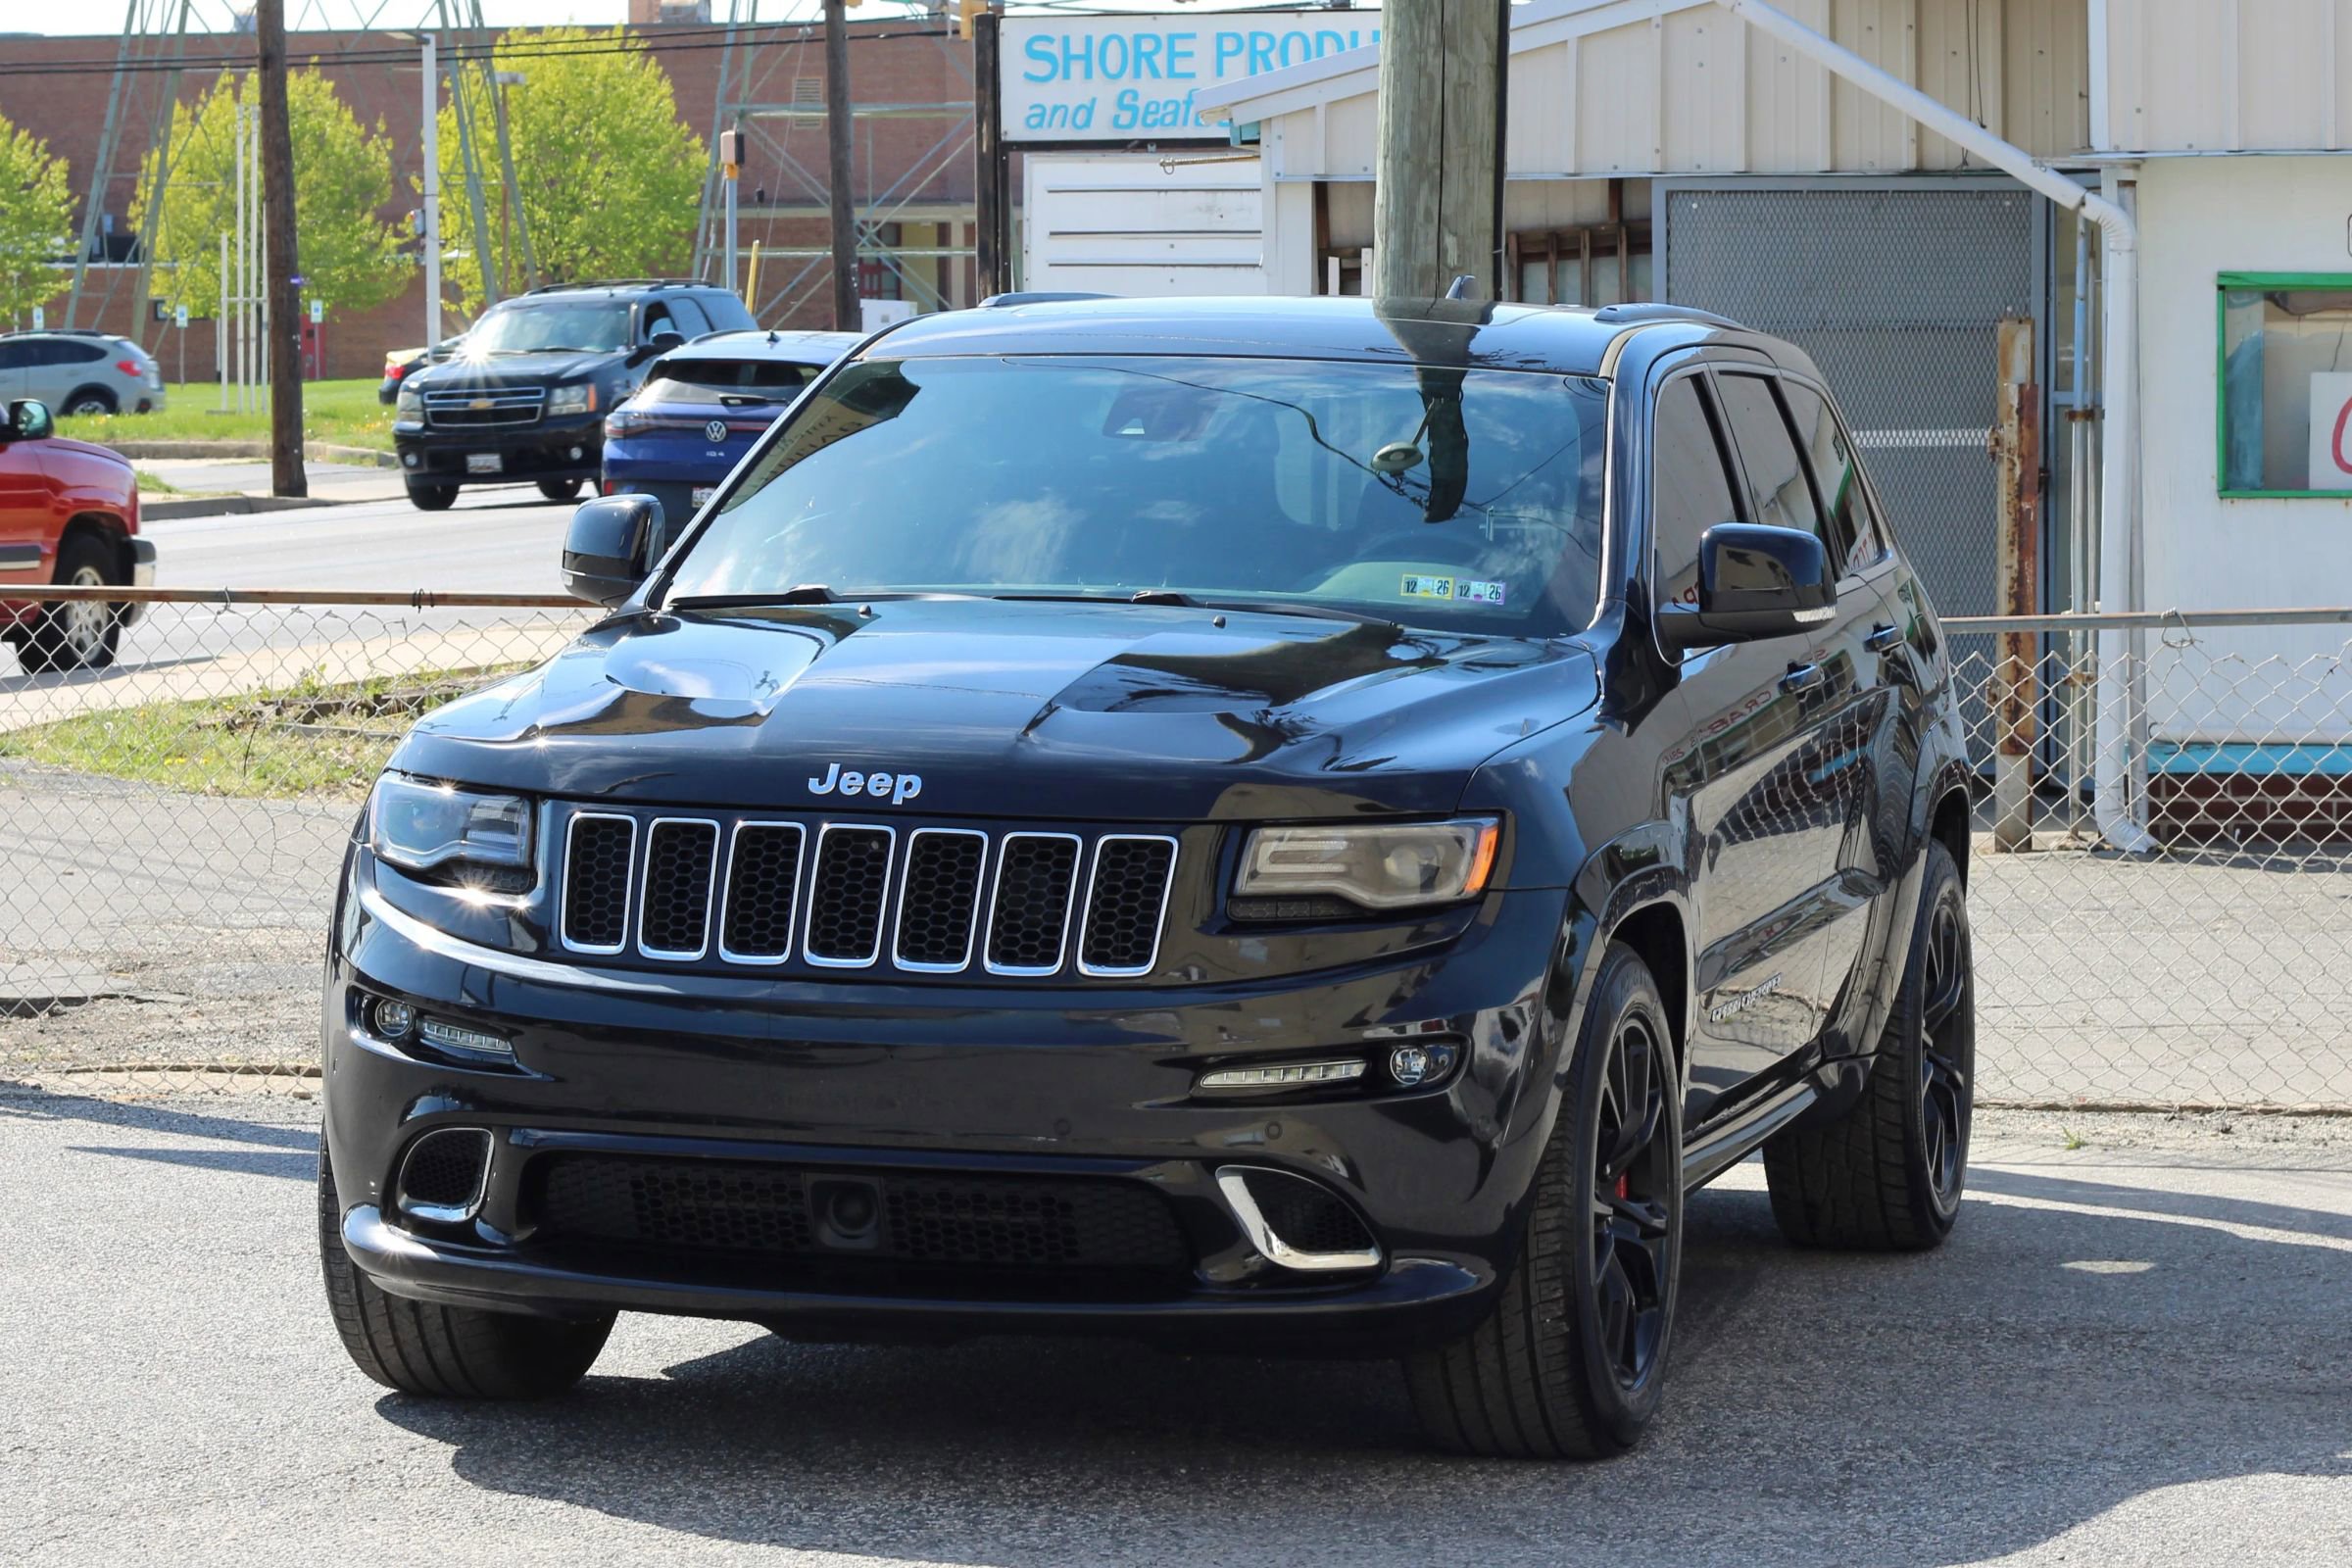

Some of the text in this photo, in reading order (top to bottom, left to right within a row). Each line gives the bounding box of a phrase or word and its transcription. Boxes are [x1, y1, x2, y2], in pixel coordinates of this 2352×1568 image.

[1022, 31, 1198, 83] SHORE
[1025, 87, 1230, 130] and Seaf
[1405, 579, 1449, 596] 12 26
[1458, 584, 1501, 600] 12 26
[808, 762, 922, 806] Jeep
